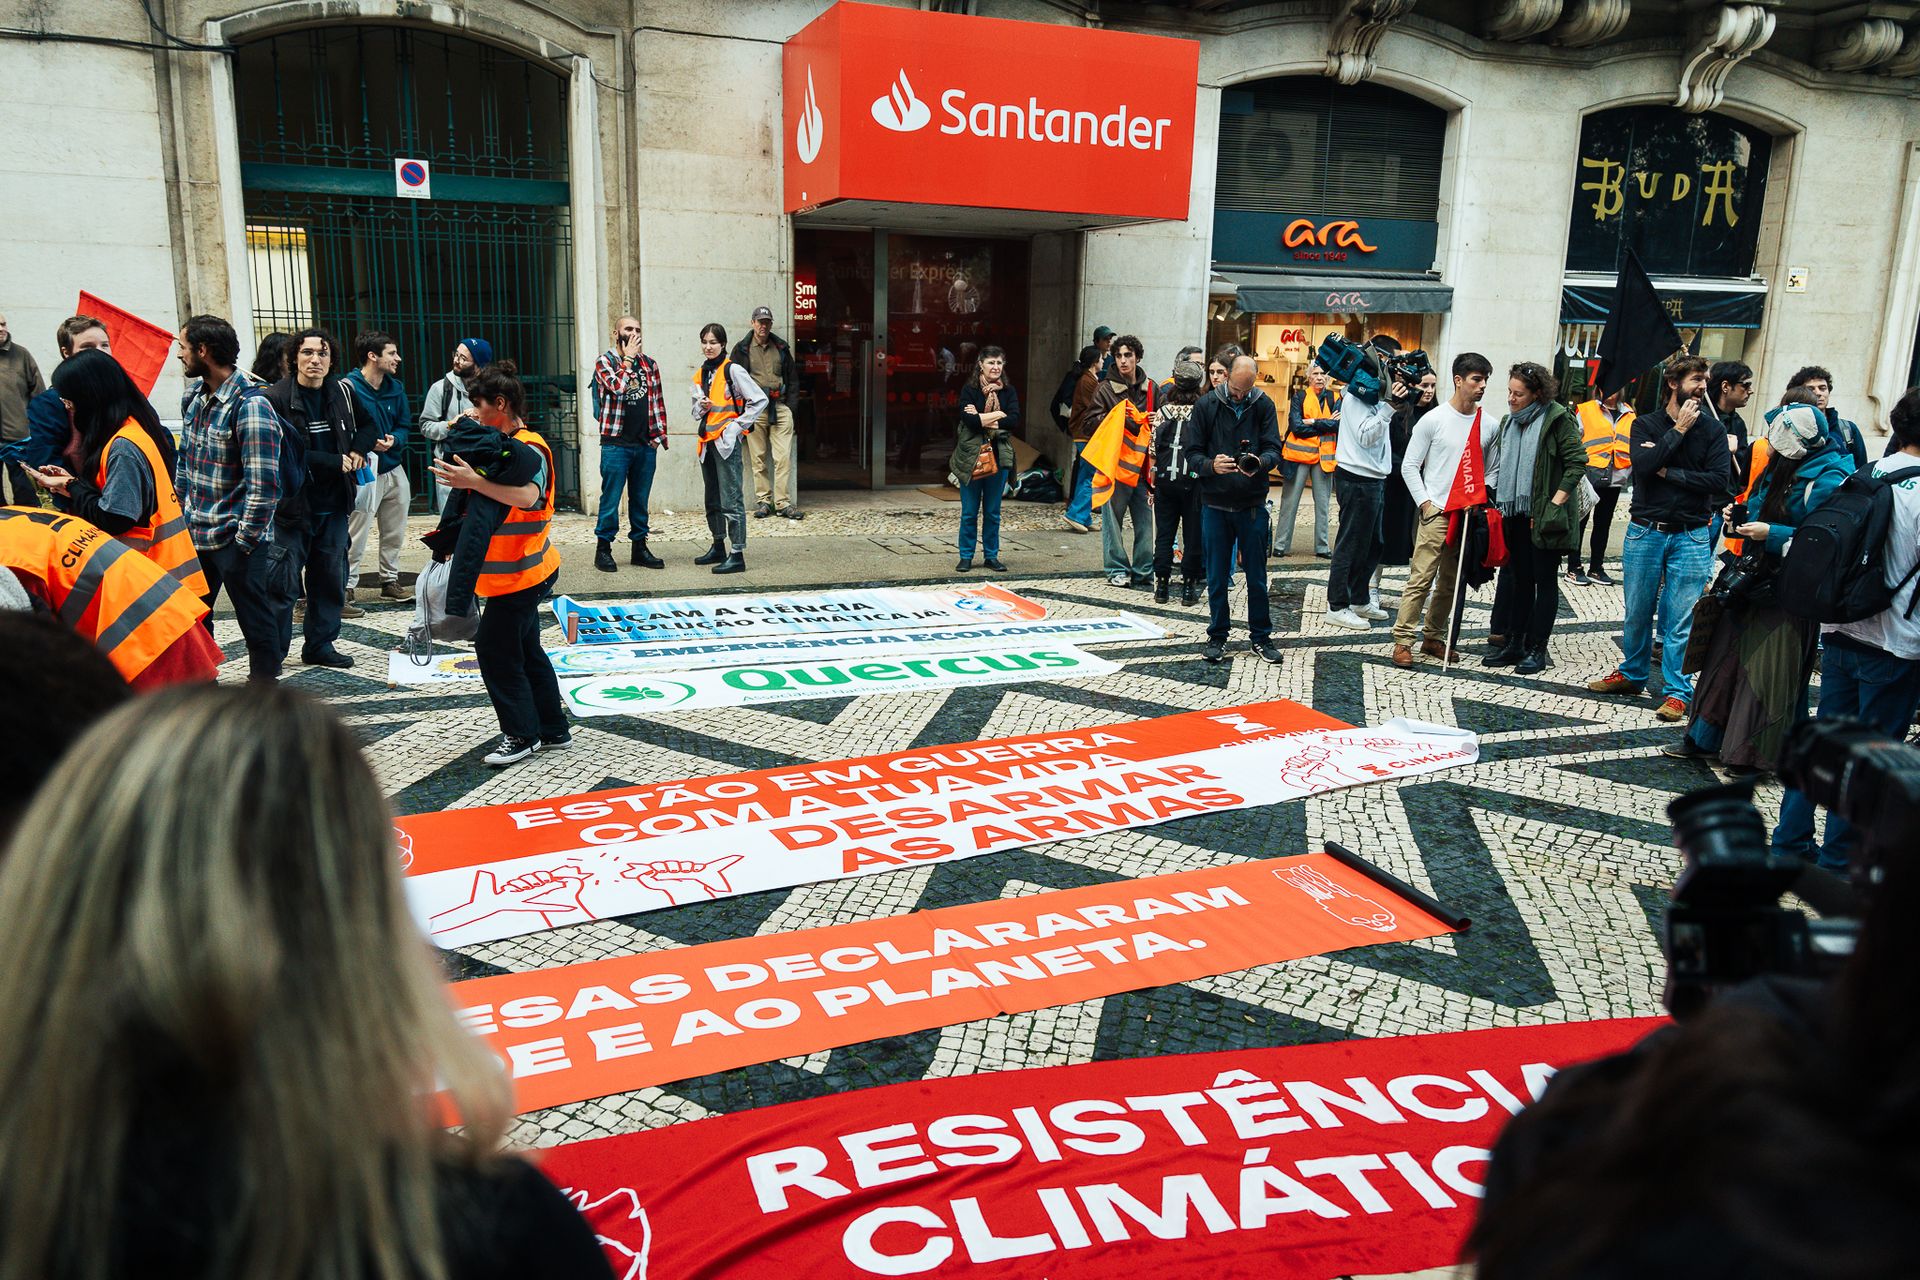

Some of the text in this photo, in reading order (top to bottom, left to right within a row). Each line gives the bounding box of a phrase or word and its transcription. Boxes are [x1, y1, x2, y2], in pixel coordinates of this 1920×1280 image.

[939, 89, 1171, 151] Santander
[1581, 158, 1739, 227] BUDA
[1282, 219, 1378, 253] ara
[1294, 251, 1348, 261] since 1949
[1325, 292, 1370, 307] ara
[1280, 329, 1311, 346] ara
[1462, 440, 1475, 495] ARMAR
[577, 602, 875, 625] OUÇAM A CIÊNCIA
[579, 608, 951, 635] REVOLUÇÃO CLIMÁTICA JÁ!
[631, 634, 907, 658] EMERGÊNCIA
[906, 621, 1133, 642] ECOLOGISTA
[722, 651, 1080, 691] Quercus
[508, 731, 1138, 830] ESTÃO EM GUERRA
[579, 752, 1139, 846] COM A TUA VIDA
[768, 764, 1222, 851] DESARMAR
[842, 787, 1245, 874] AS ARMAS
[453, 885, 1252, 1036] ESAS DECLARARAM
[586, 1022, 654, 1062] E
[671, 997, 802, 1047] AO
[813, 931, 1208, 1018] PLANETA.
[842, 1145, 1493, 1277] CLIMÁTIC
